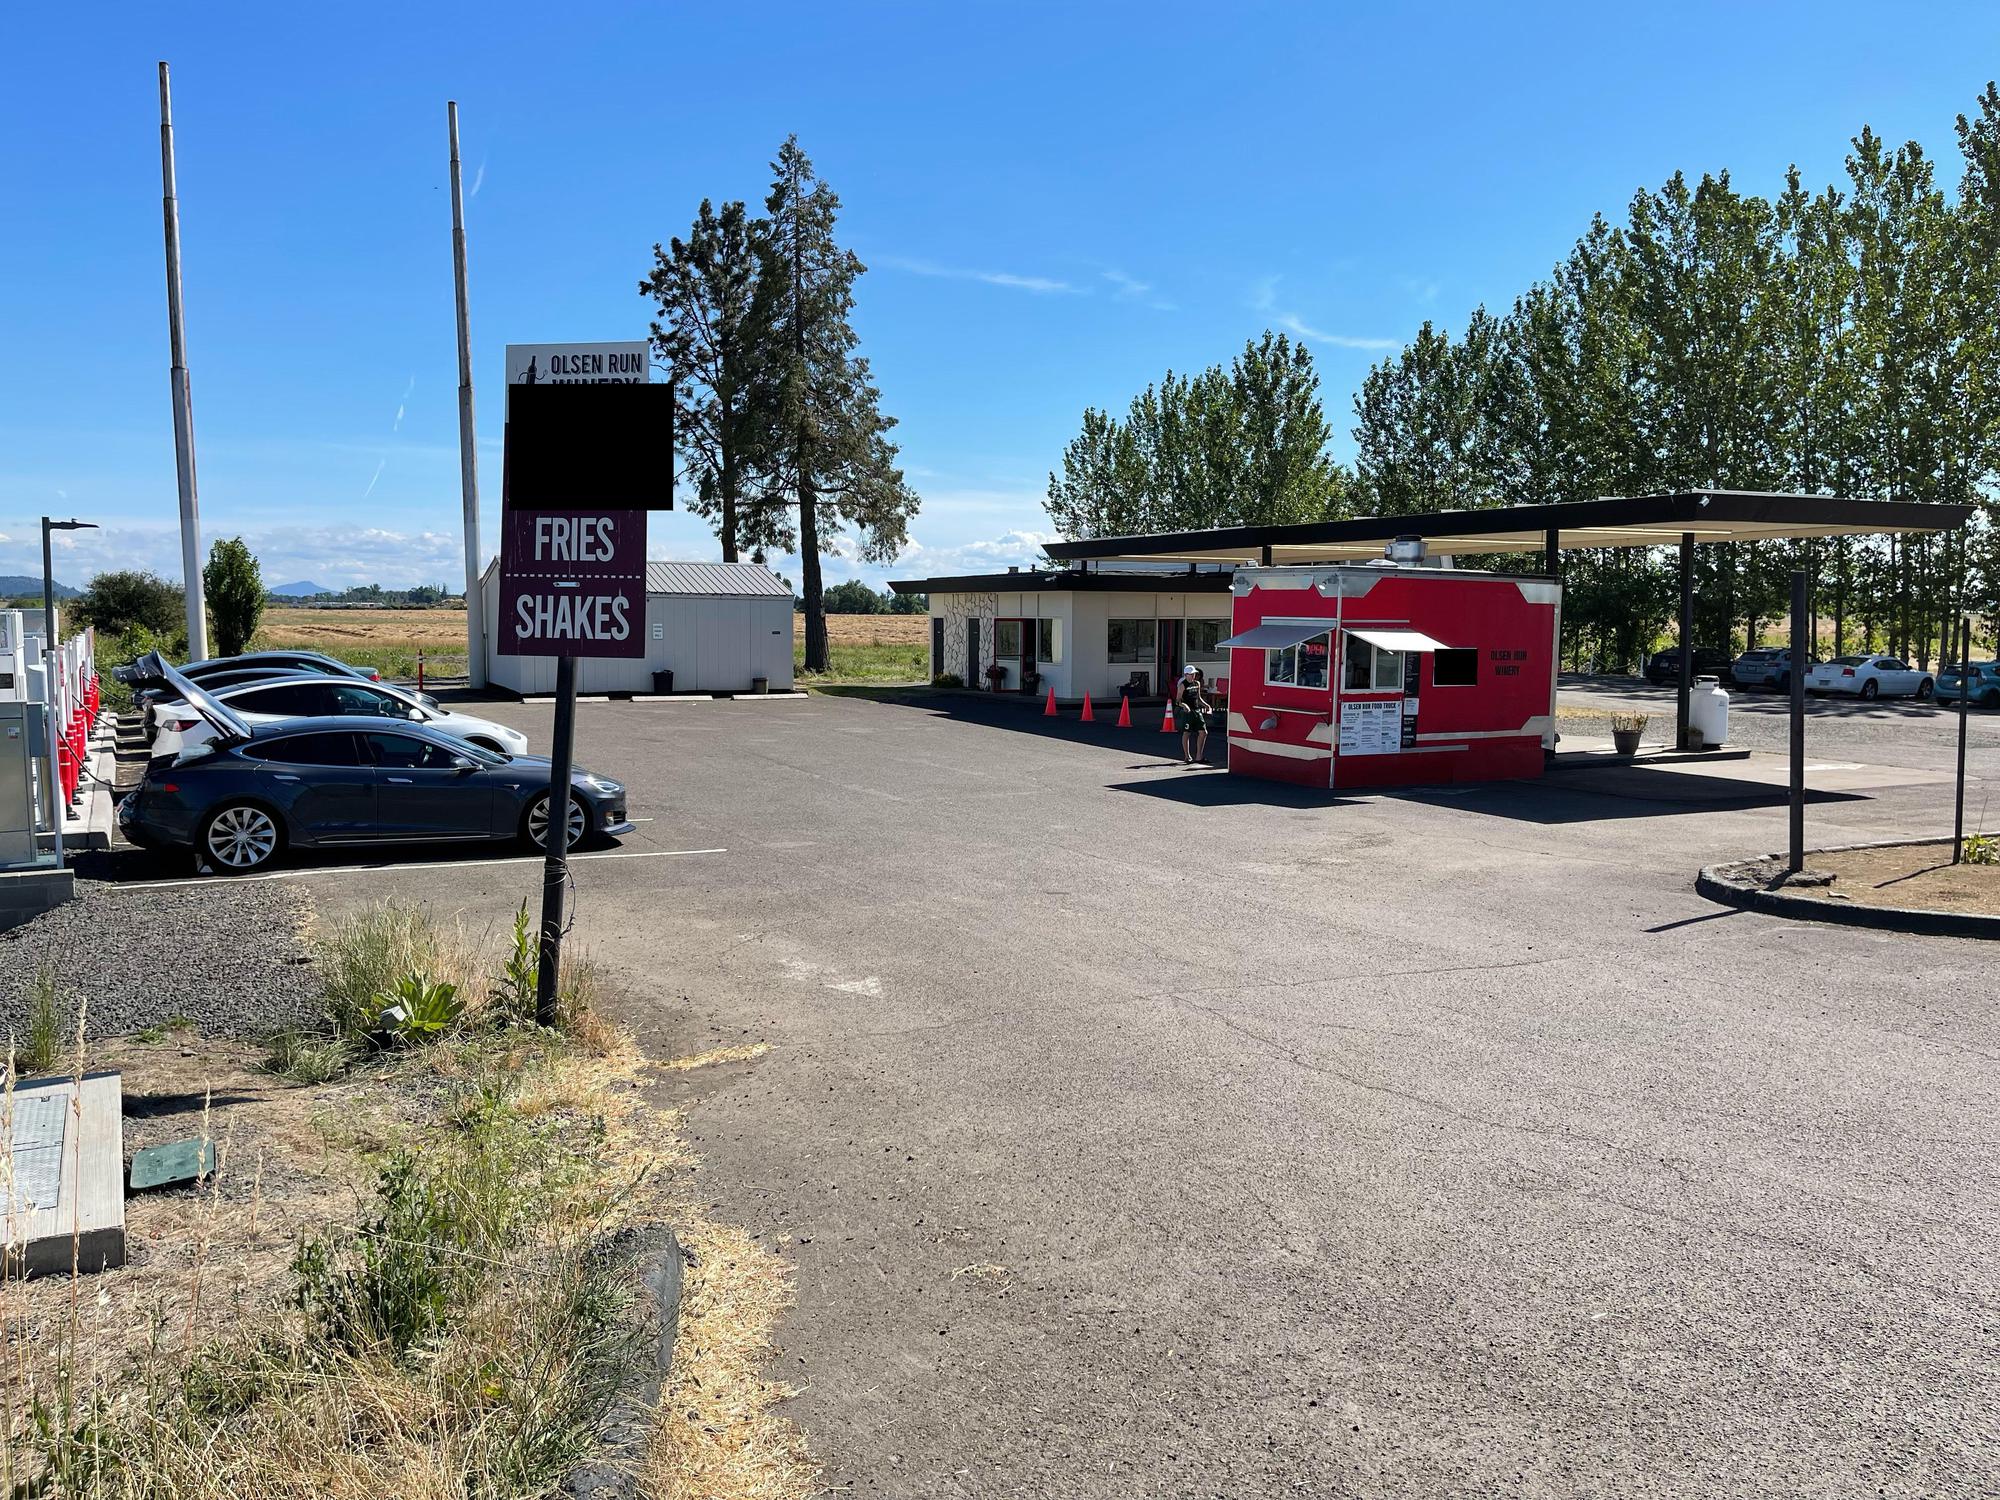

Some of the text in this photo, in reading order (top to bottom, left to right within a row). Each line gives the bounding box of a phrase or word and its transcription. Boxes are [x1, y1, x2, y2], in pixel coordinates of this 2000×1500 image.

[551, 353, 643, 375] OLSEN RUN
[534, 517, 615, 562] FRIES
[515, 593, 630, 641] SHAKES
[1490, 650, 1511, 660] OLSEN
[1495, 666, 1520, 676] WINERY
